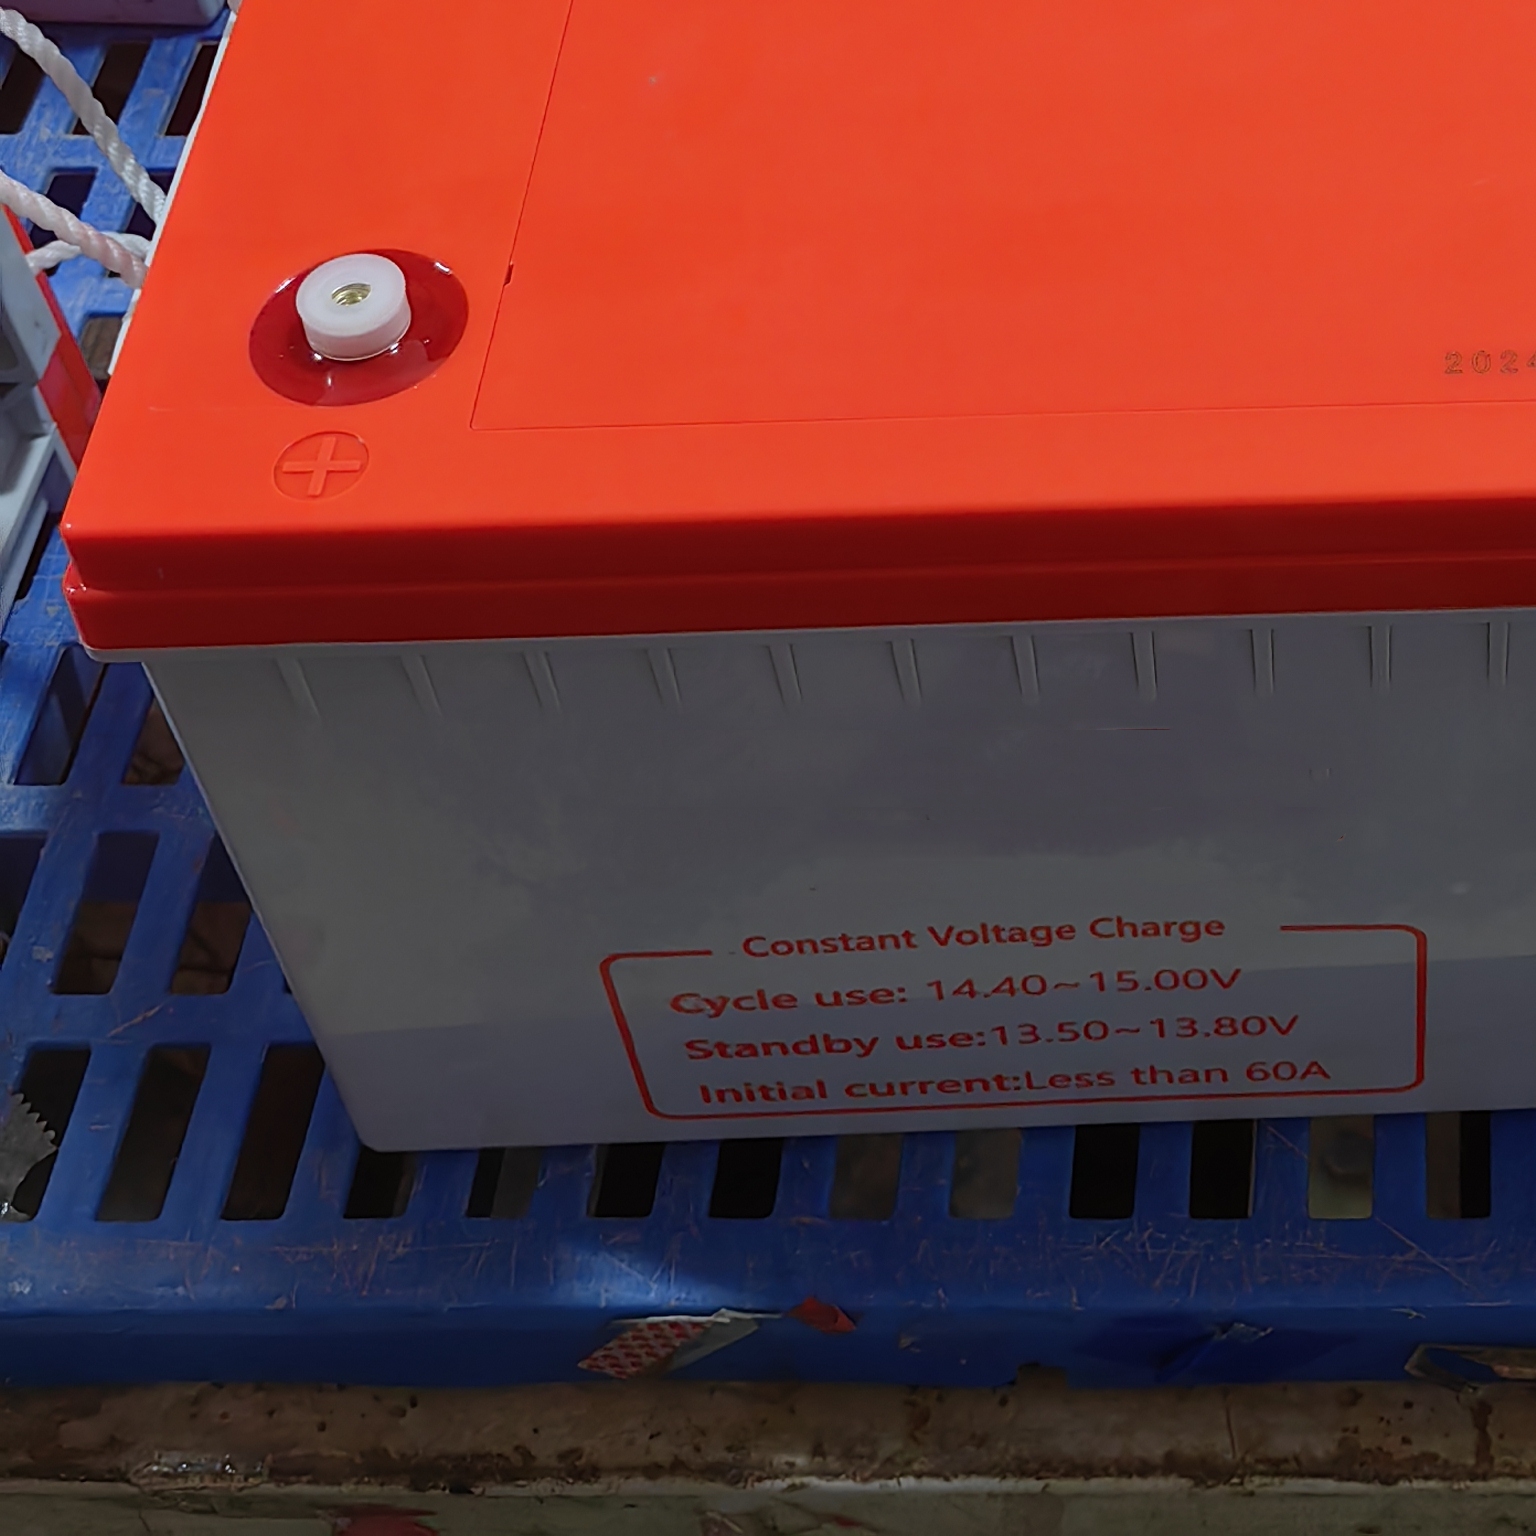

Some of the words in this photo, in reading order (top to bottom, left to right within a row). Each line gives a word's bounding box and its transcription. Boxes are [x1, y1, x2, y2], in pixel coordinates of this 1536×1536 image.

[741, 930, 917, 958] Constant
[926, 923, 1076, 948] Voltage
[1088, 916, 1225, 944] Charge
[669, 989, 797, 1018] Cycle
[814, 988, 906, 1008] use:
[928, 968, 1241, 1001] 14.40~15.00V
[684, 1034, 878, 1062] Standby
[699, 1079, 827, 1104] Initial
[1131, 1066, 1229, 1086] than
[1244, 1061, 1330, 1083] 60A
